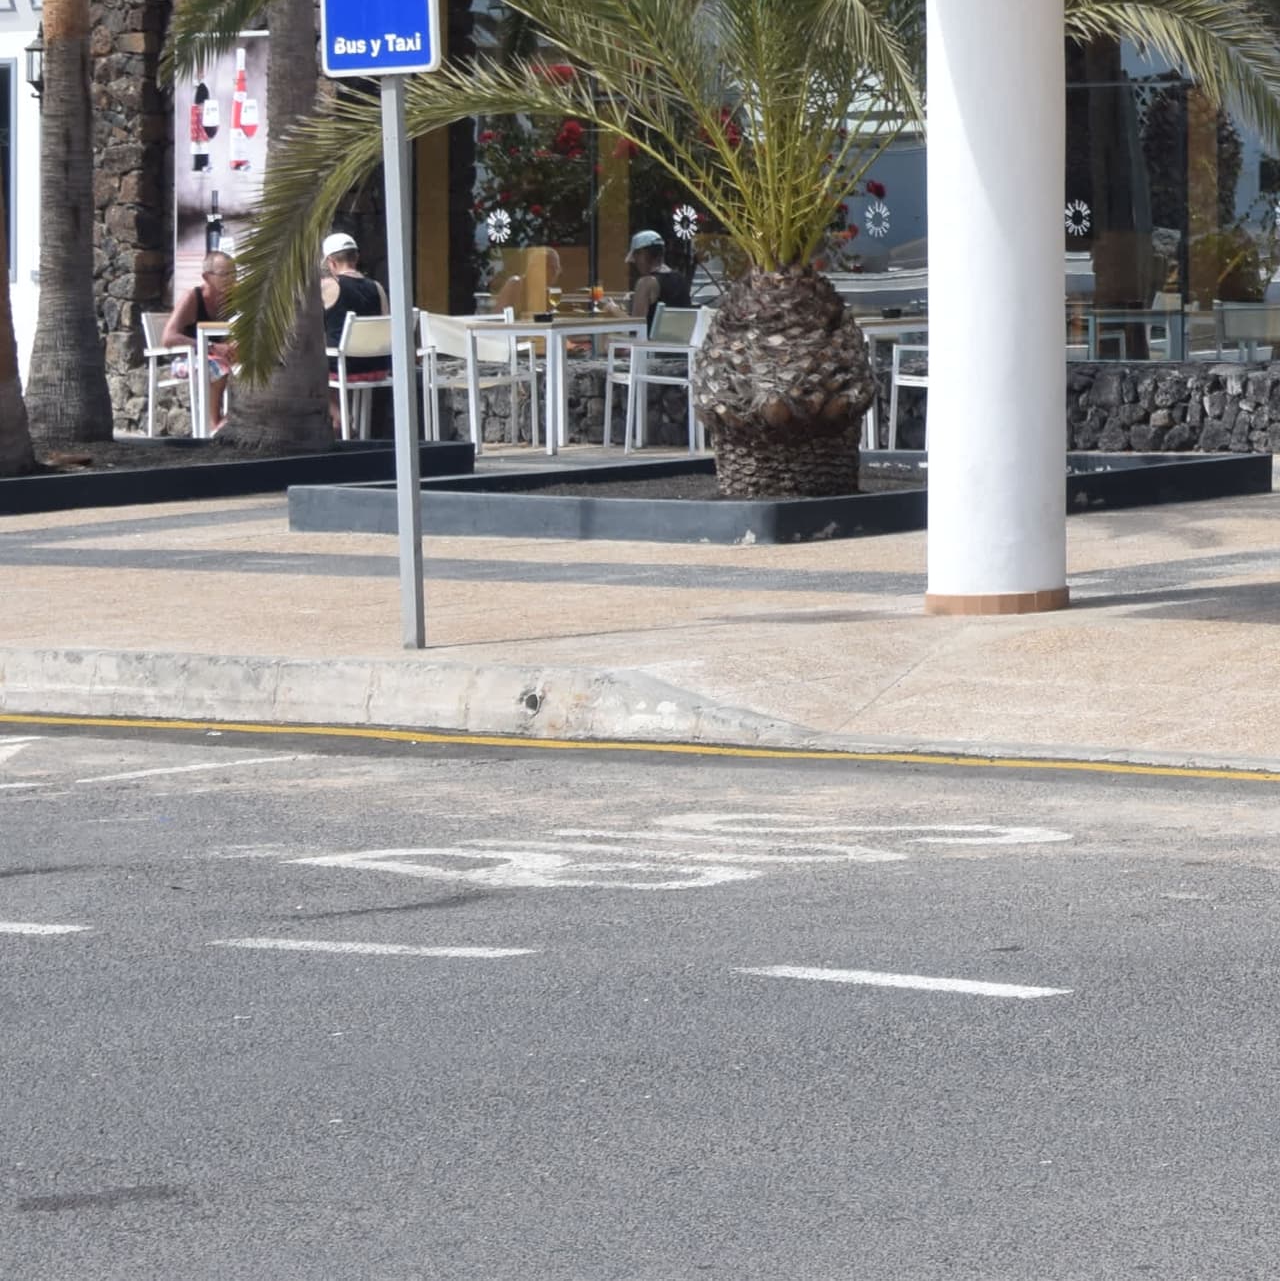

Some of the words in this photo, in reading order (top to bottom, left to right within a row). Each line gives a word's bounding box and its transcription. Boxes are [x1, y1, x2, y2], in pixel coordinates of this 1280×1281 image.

[334, 37, 366, 54] Bus
[370, 39, 381, 57] y
[384, 32, 422, 52] Taxi
